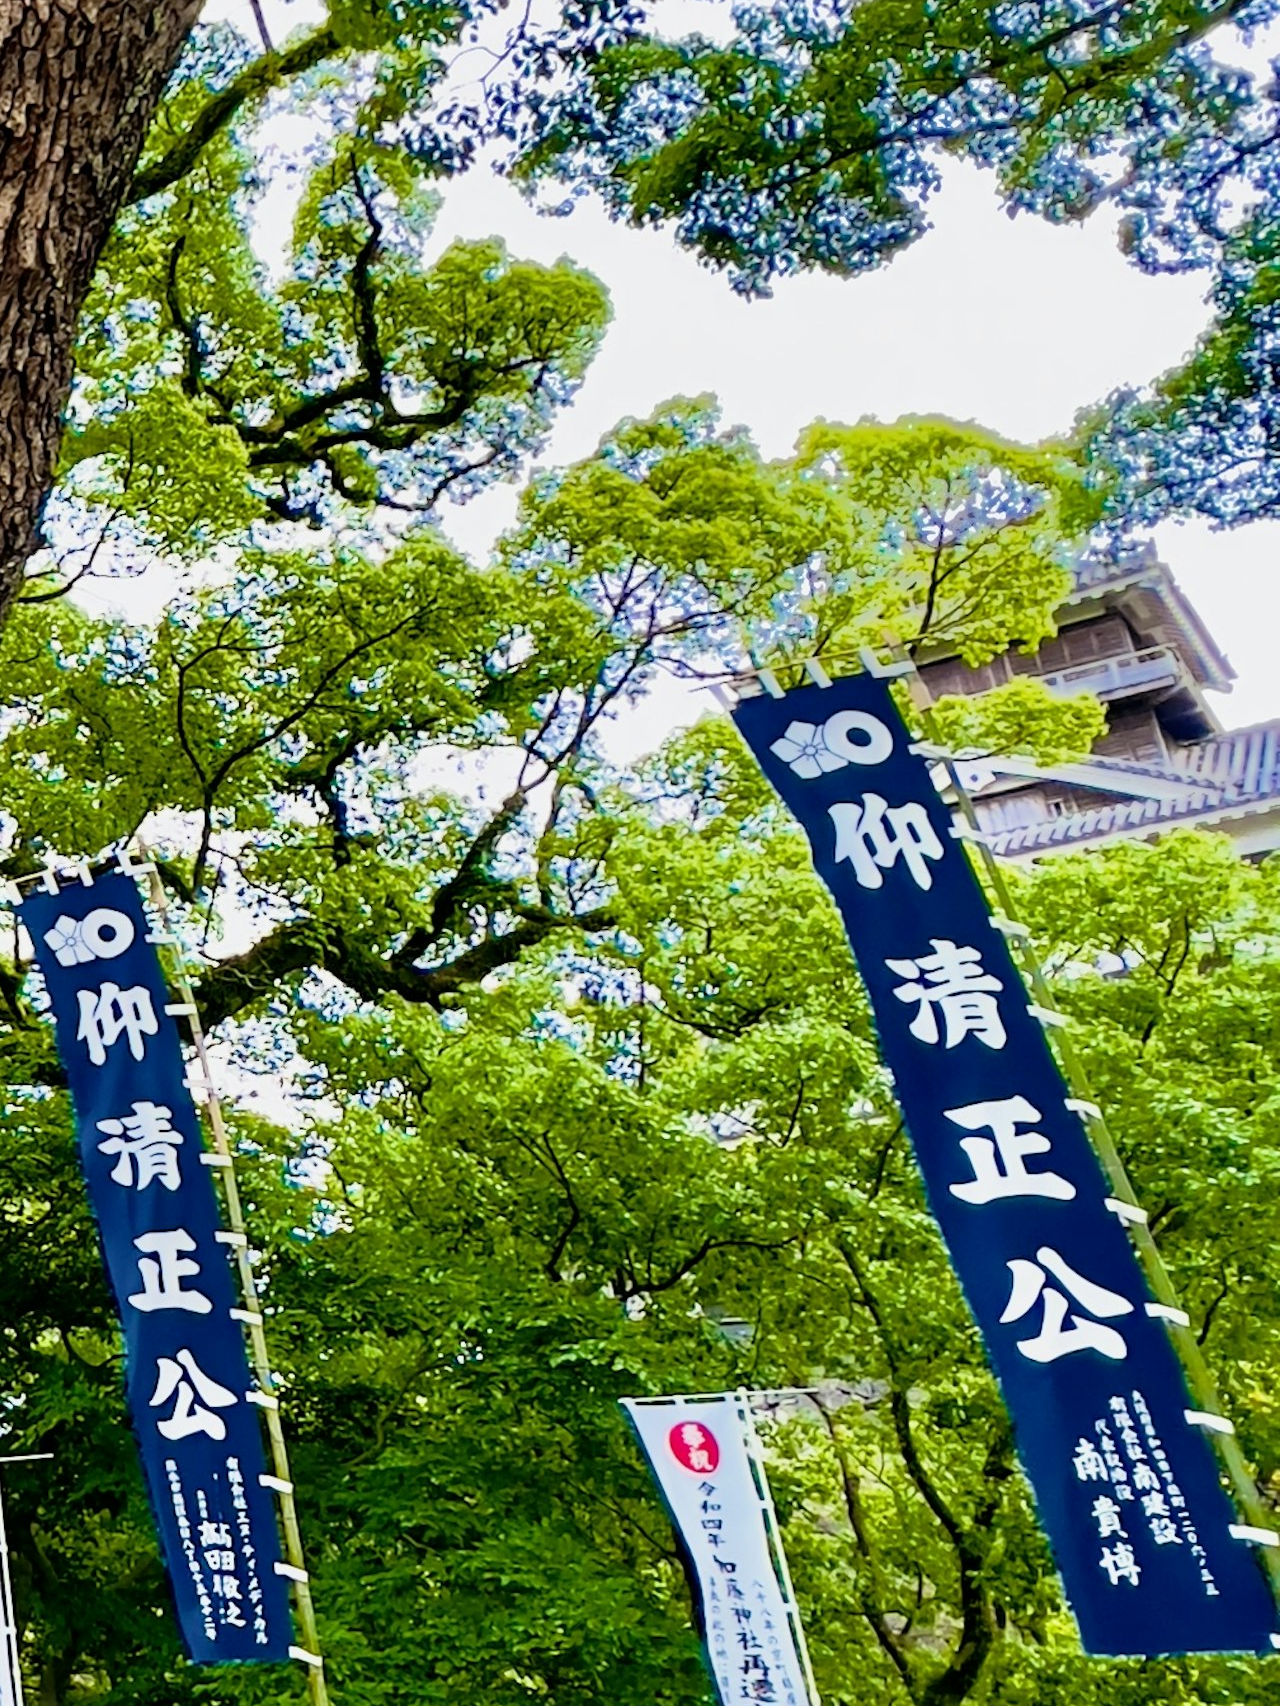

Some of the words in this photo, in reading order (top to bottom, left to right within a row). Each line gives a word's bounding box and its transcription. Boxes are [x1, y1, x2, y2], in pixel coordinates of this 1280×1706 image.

[75, 981, 239, 1441] 仰清正公
[827, 792, 1135, 1363] 仰清正公
[697, 1481, 726, 1549] 令和四年
[1072, 1437, 1142, 1587] 南貴博
